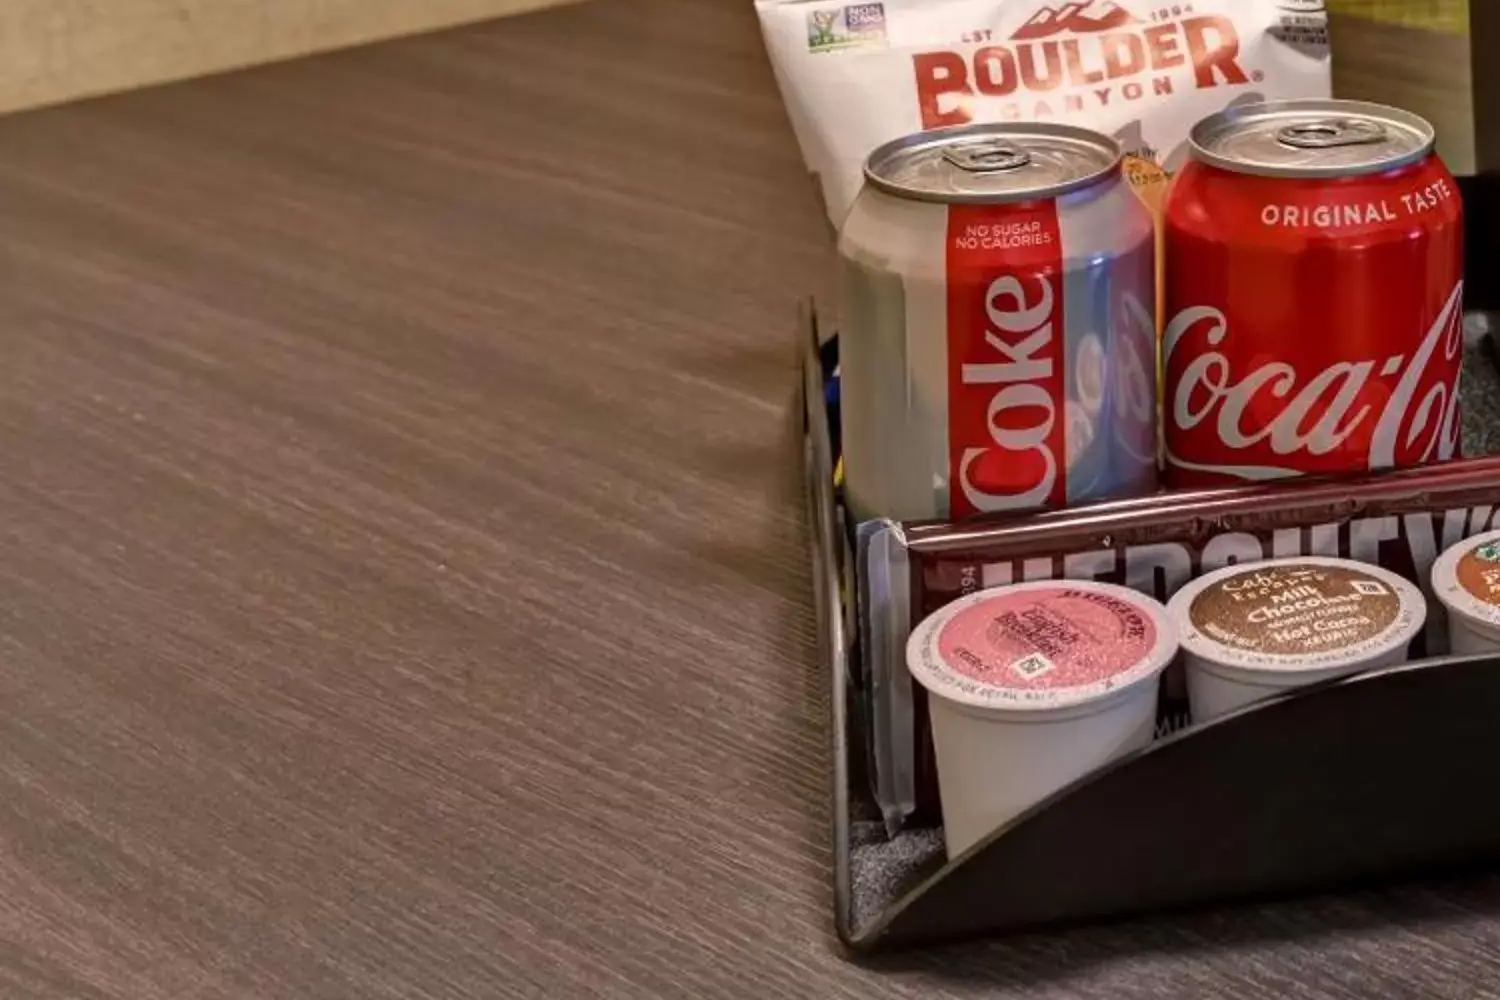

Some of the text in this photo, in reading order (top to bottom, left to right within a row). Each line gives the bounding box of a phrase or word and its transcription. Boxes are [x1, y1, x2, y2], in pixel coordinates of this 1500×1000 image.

[912, 14, 1249, 131] BOULDER
[1001, 76, 1174, 120] CANYON
[1261, 179, 1451, 228] ORIGINAL TASTE
[955, 232, 1053, 249] NO CALORIES
[965, 221, 1041, 238] NO SUGAR
[959, 274, 1057, 512] Coke
